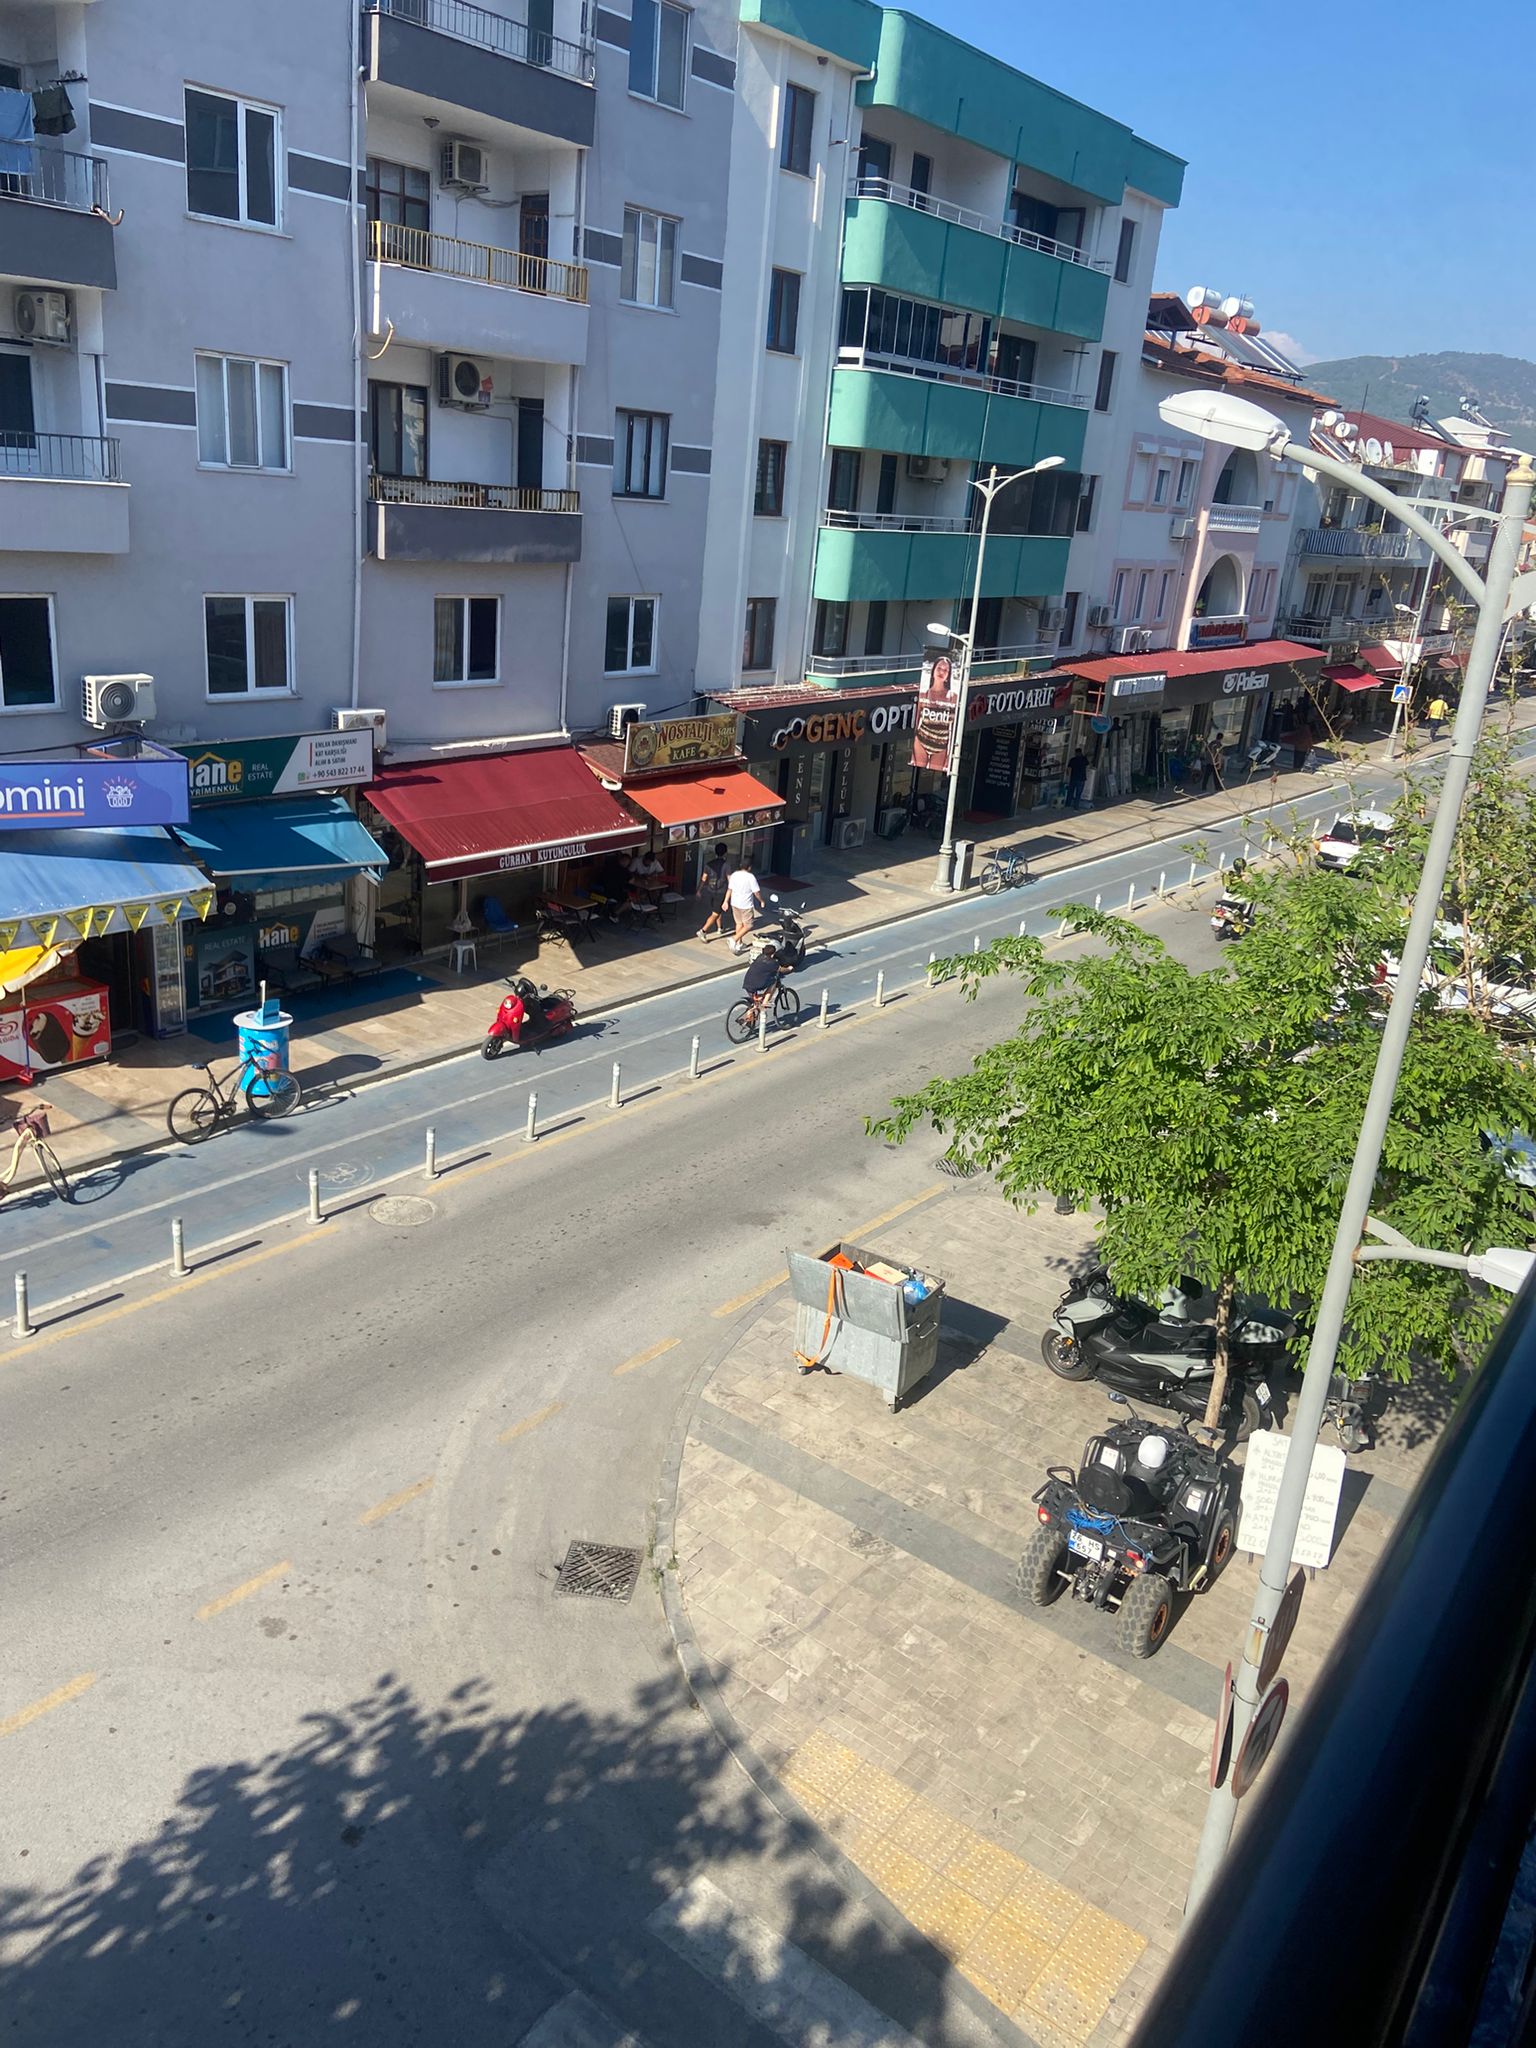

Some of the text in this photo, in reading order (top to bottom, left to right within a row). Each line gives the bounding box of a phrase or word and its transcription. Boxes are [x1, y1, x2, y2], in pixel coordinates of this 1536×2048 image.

[986, 689, 1025, 715] FOTO
[806, 696, 918, 743] GENÇ OPTİ
[921, 707, 950, 724] Penti
[672, 746, 697, 761] KAFE
[252, 763, 269, 772] REAL
[248, 771, 273, 782] ESTATE
[190, 784, 240, 797] YRİMENKUL
[500, 843, 587, 869] GÜRHAN KUYUMCULUK
[259, 924, 299, 949] Hane
